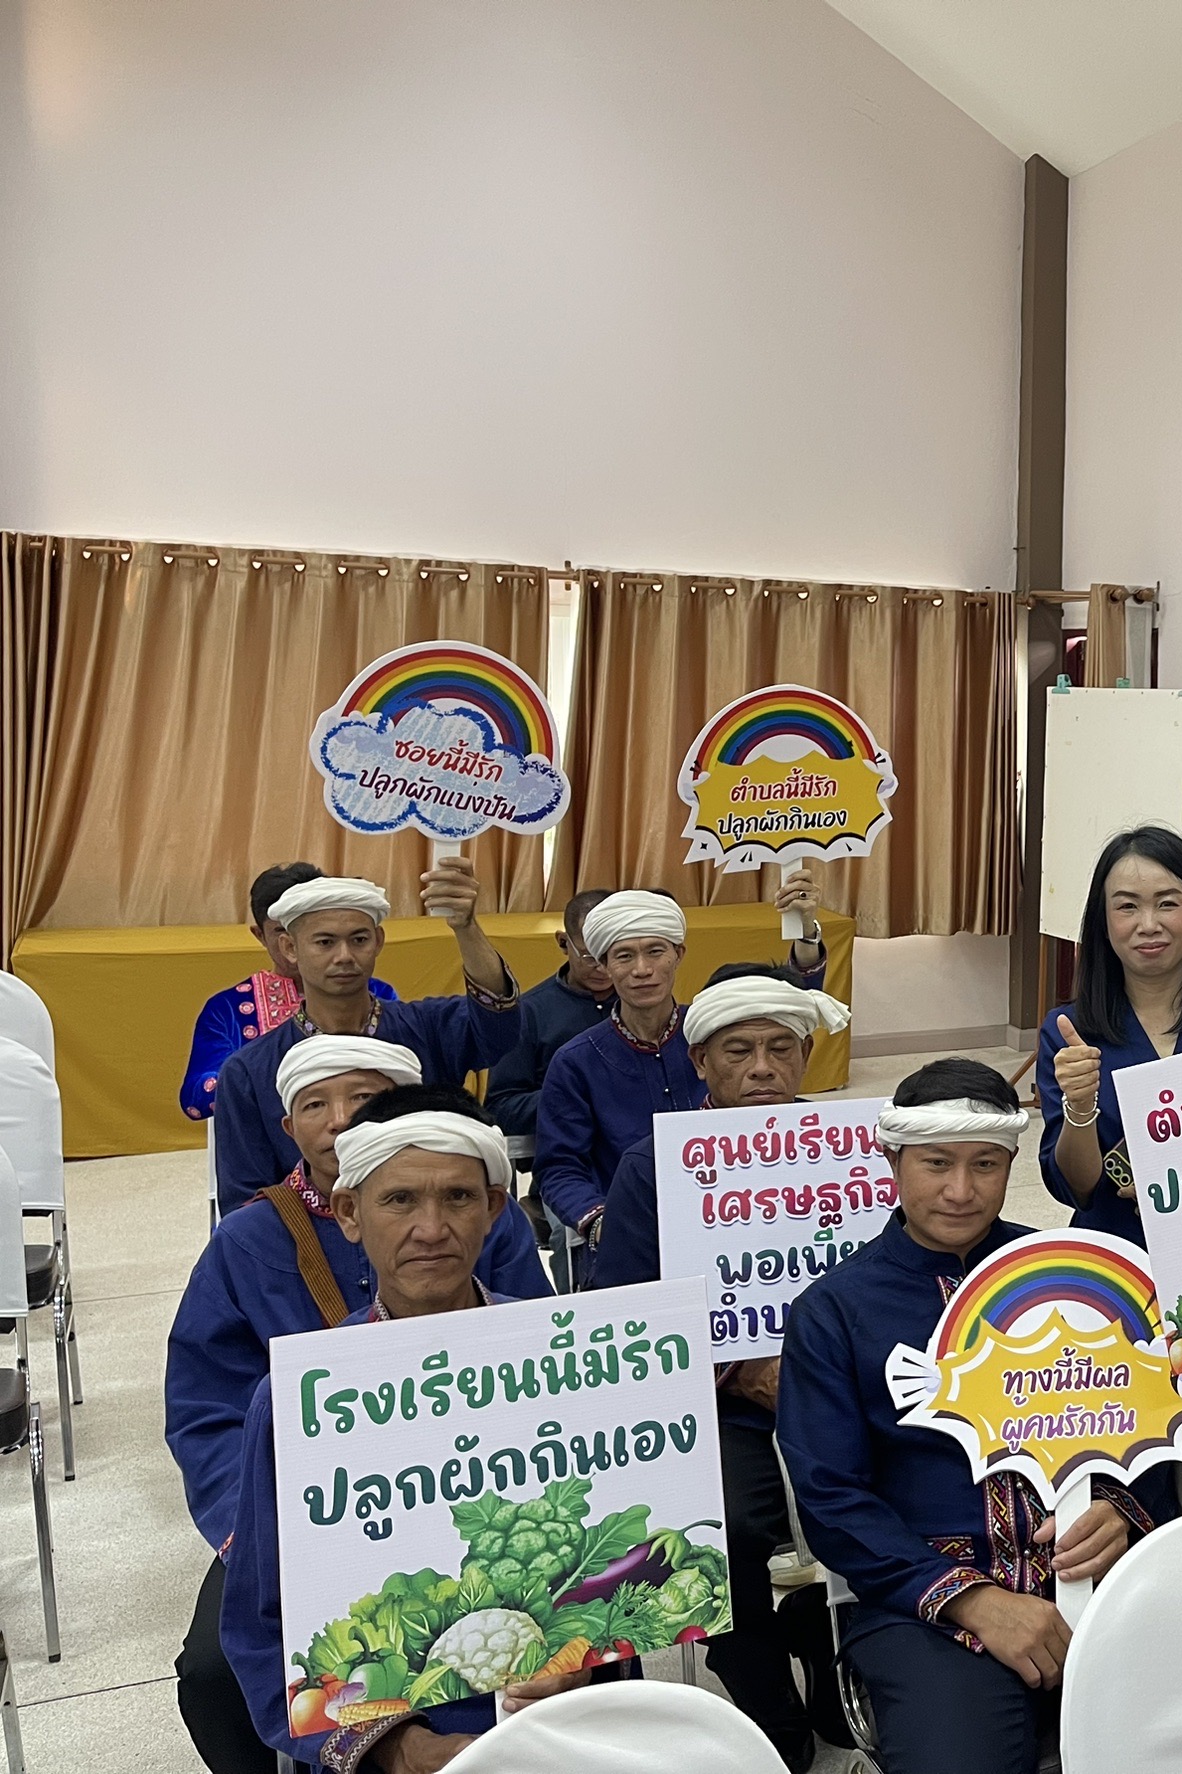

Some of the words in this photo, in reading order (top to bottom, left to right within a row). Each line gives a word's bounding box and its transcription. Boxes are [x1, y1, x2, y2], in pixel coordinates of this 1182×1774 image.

[395, 739, 503, 783] ซอยนี้มีรัก
[731, 767, 837, 802] ตำบลนี้มีรัก
[718, 806, 847, 841] ปลูกผักกินเอง
[703, 1166, 899, 1228] เศรษฐกิจ
[300, 1310, 690, 1438] โรงเรียนนี้มีรัก
[1003, 1347, 1130, 1394] ทางนี้มีผล
[303, 1413, 697, 1541] ปลูกผักกินเอง
